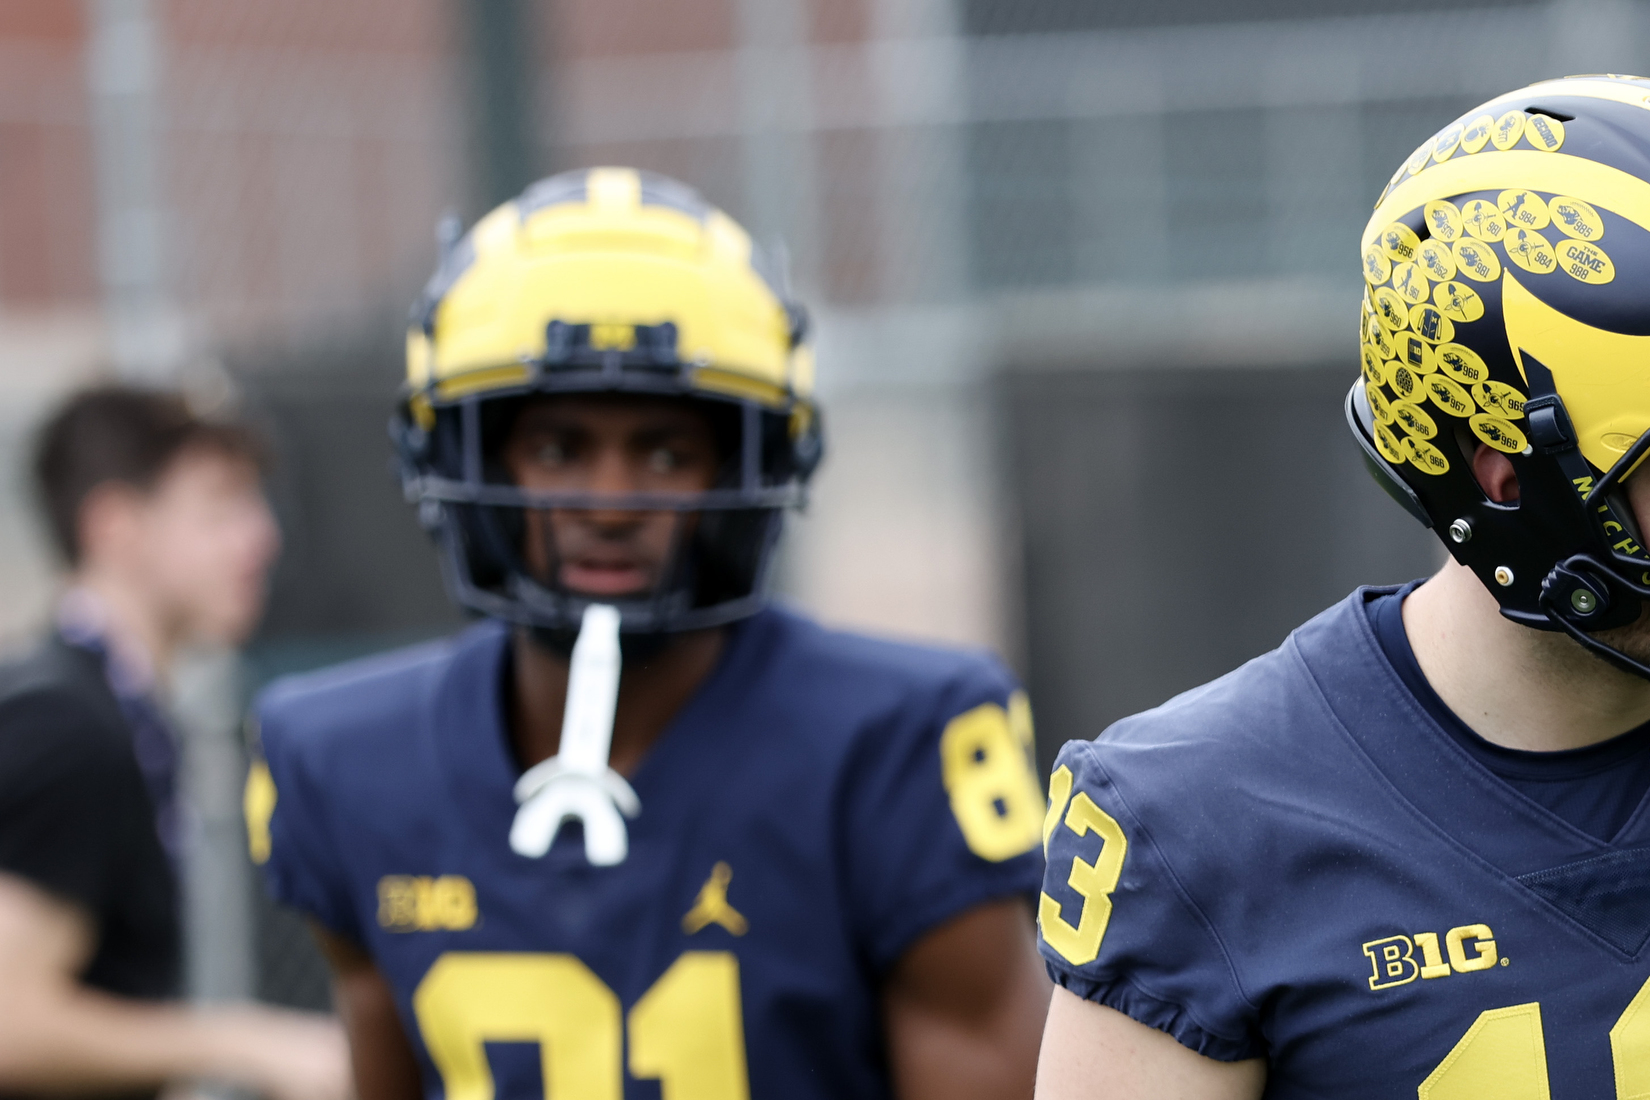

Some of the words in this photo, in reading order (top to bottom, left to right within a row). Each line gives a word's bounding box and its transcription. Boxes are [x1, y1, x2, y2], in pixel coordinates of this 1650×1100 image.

[1531, 117, 1558, 148] RECORD
[1519, 210, 1536, 225] 984
[1441, 223, 1455, 239] 979
[1486, 221, 1501, 237] 981
[1573, 220, 1593, 238] 985
[1398, 243, 1414, 259] 956
[1583, 245, 1598, 257] THE
[1534, 251, 1553, 269] 984
[1566, 246, 1605, 274] GAME
[1433, 264, 1448, 279] 962
[1475, 262, 1491, 279] 981
[1570, 263, 1589, 280] 988
[1463, 365, 1479, 380] 968
[1450, 398, 1466, 413] 967
[1414, 422, 1430, 436] 966
[1501, 435, 1518, 450] 969
[1429, 455, 1445, 469] 966
